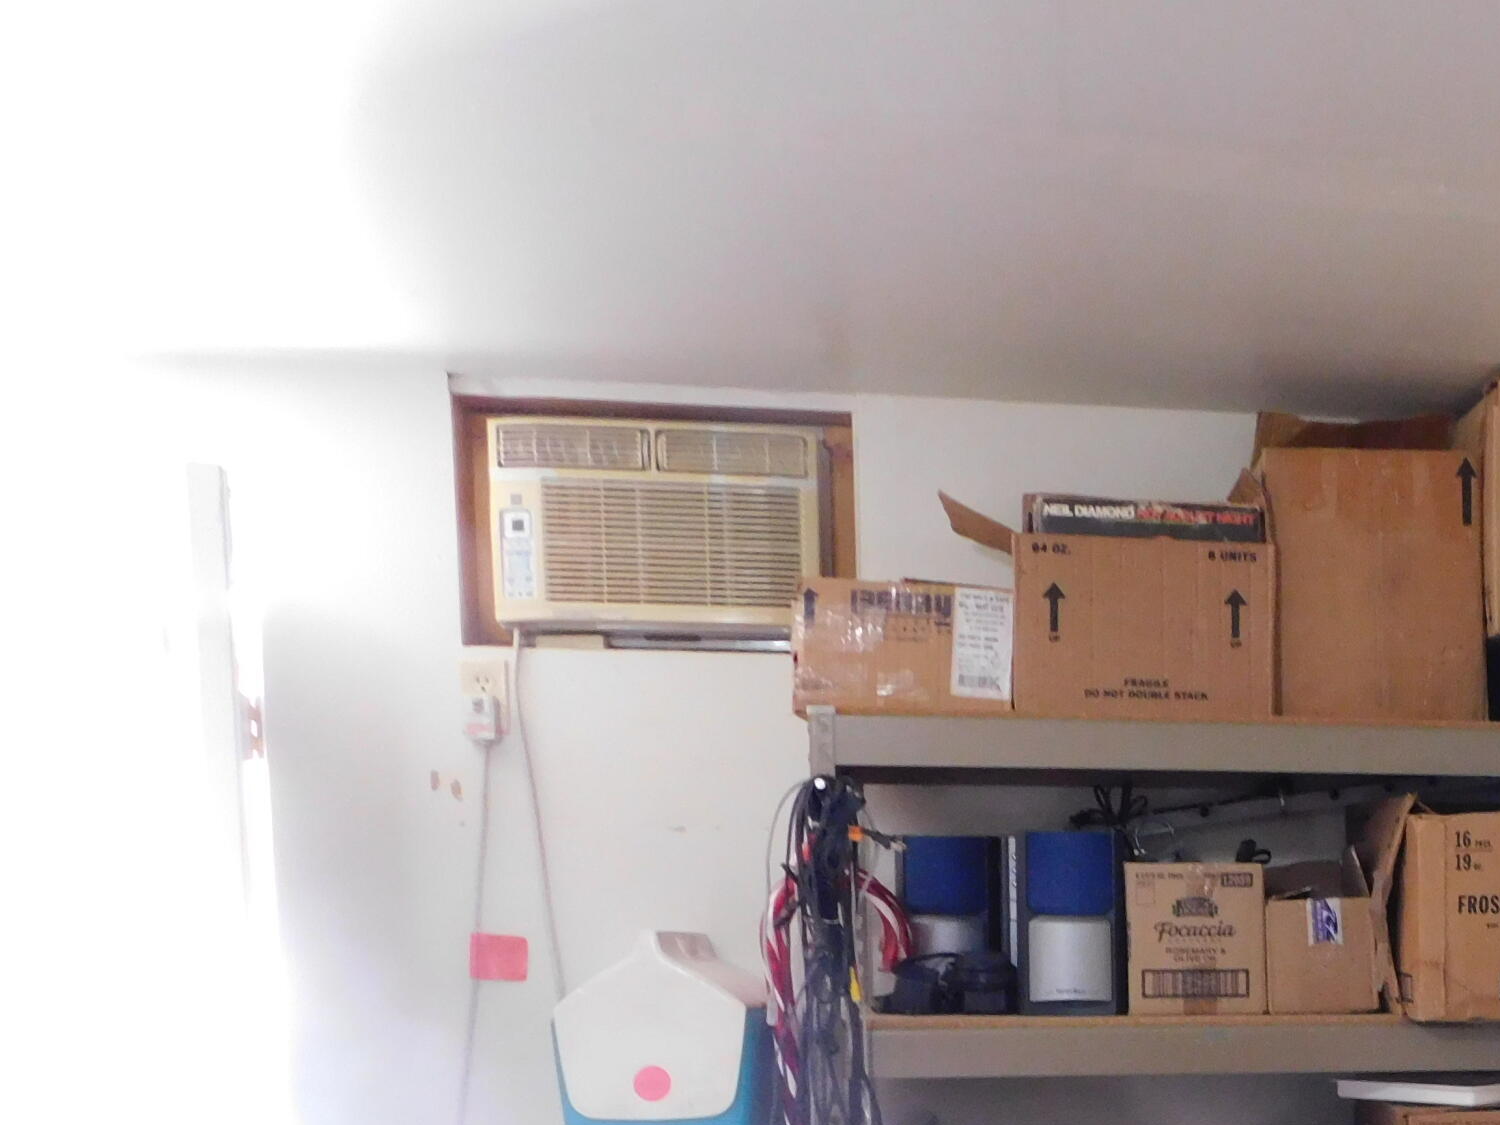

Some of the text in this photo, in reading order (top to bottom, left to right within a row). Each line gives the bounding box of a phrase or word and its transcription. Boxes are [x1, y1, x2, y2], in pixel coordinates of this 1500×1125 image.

[1042, 502, 1073, 518] NEIL
[1074, 503, 1136, 520] DIAMOND
[1220, 550, 1258, 563] UNITS
[1103, 688, 1125, 699] NOT
[1128, 689, 1170, 700] DOUBLE
[1455, 830, 1472, 848] 16
[1455, 853, 1472, 871] 19
[1153, 920, 1236, 943] Focaccia
